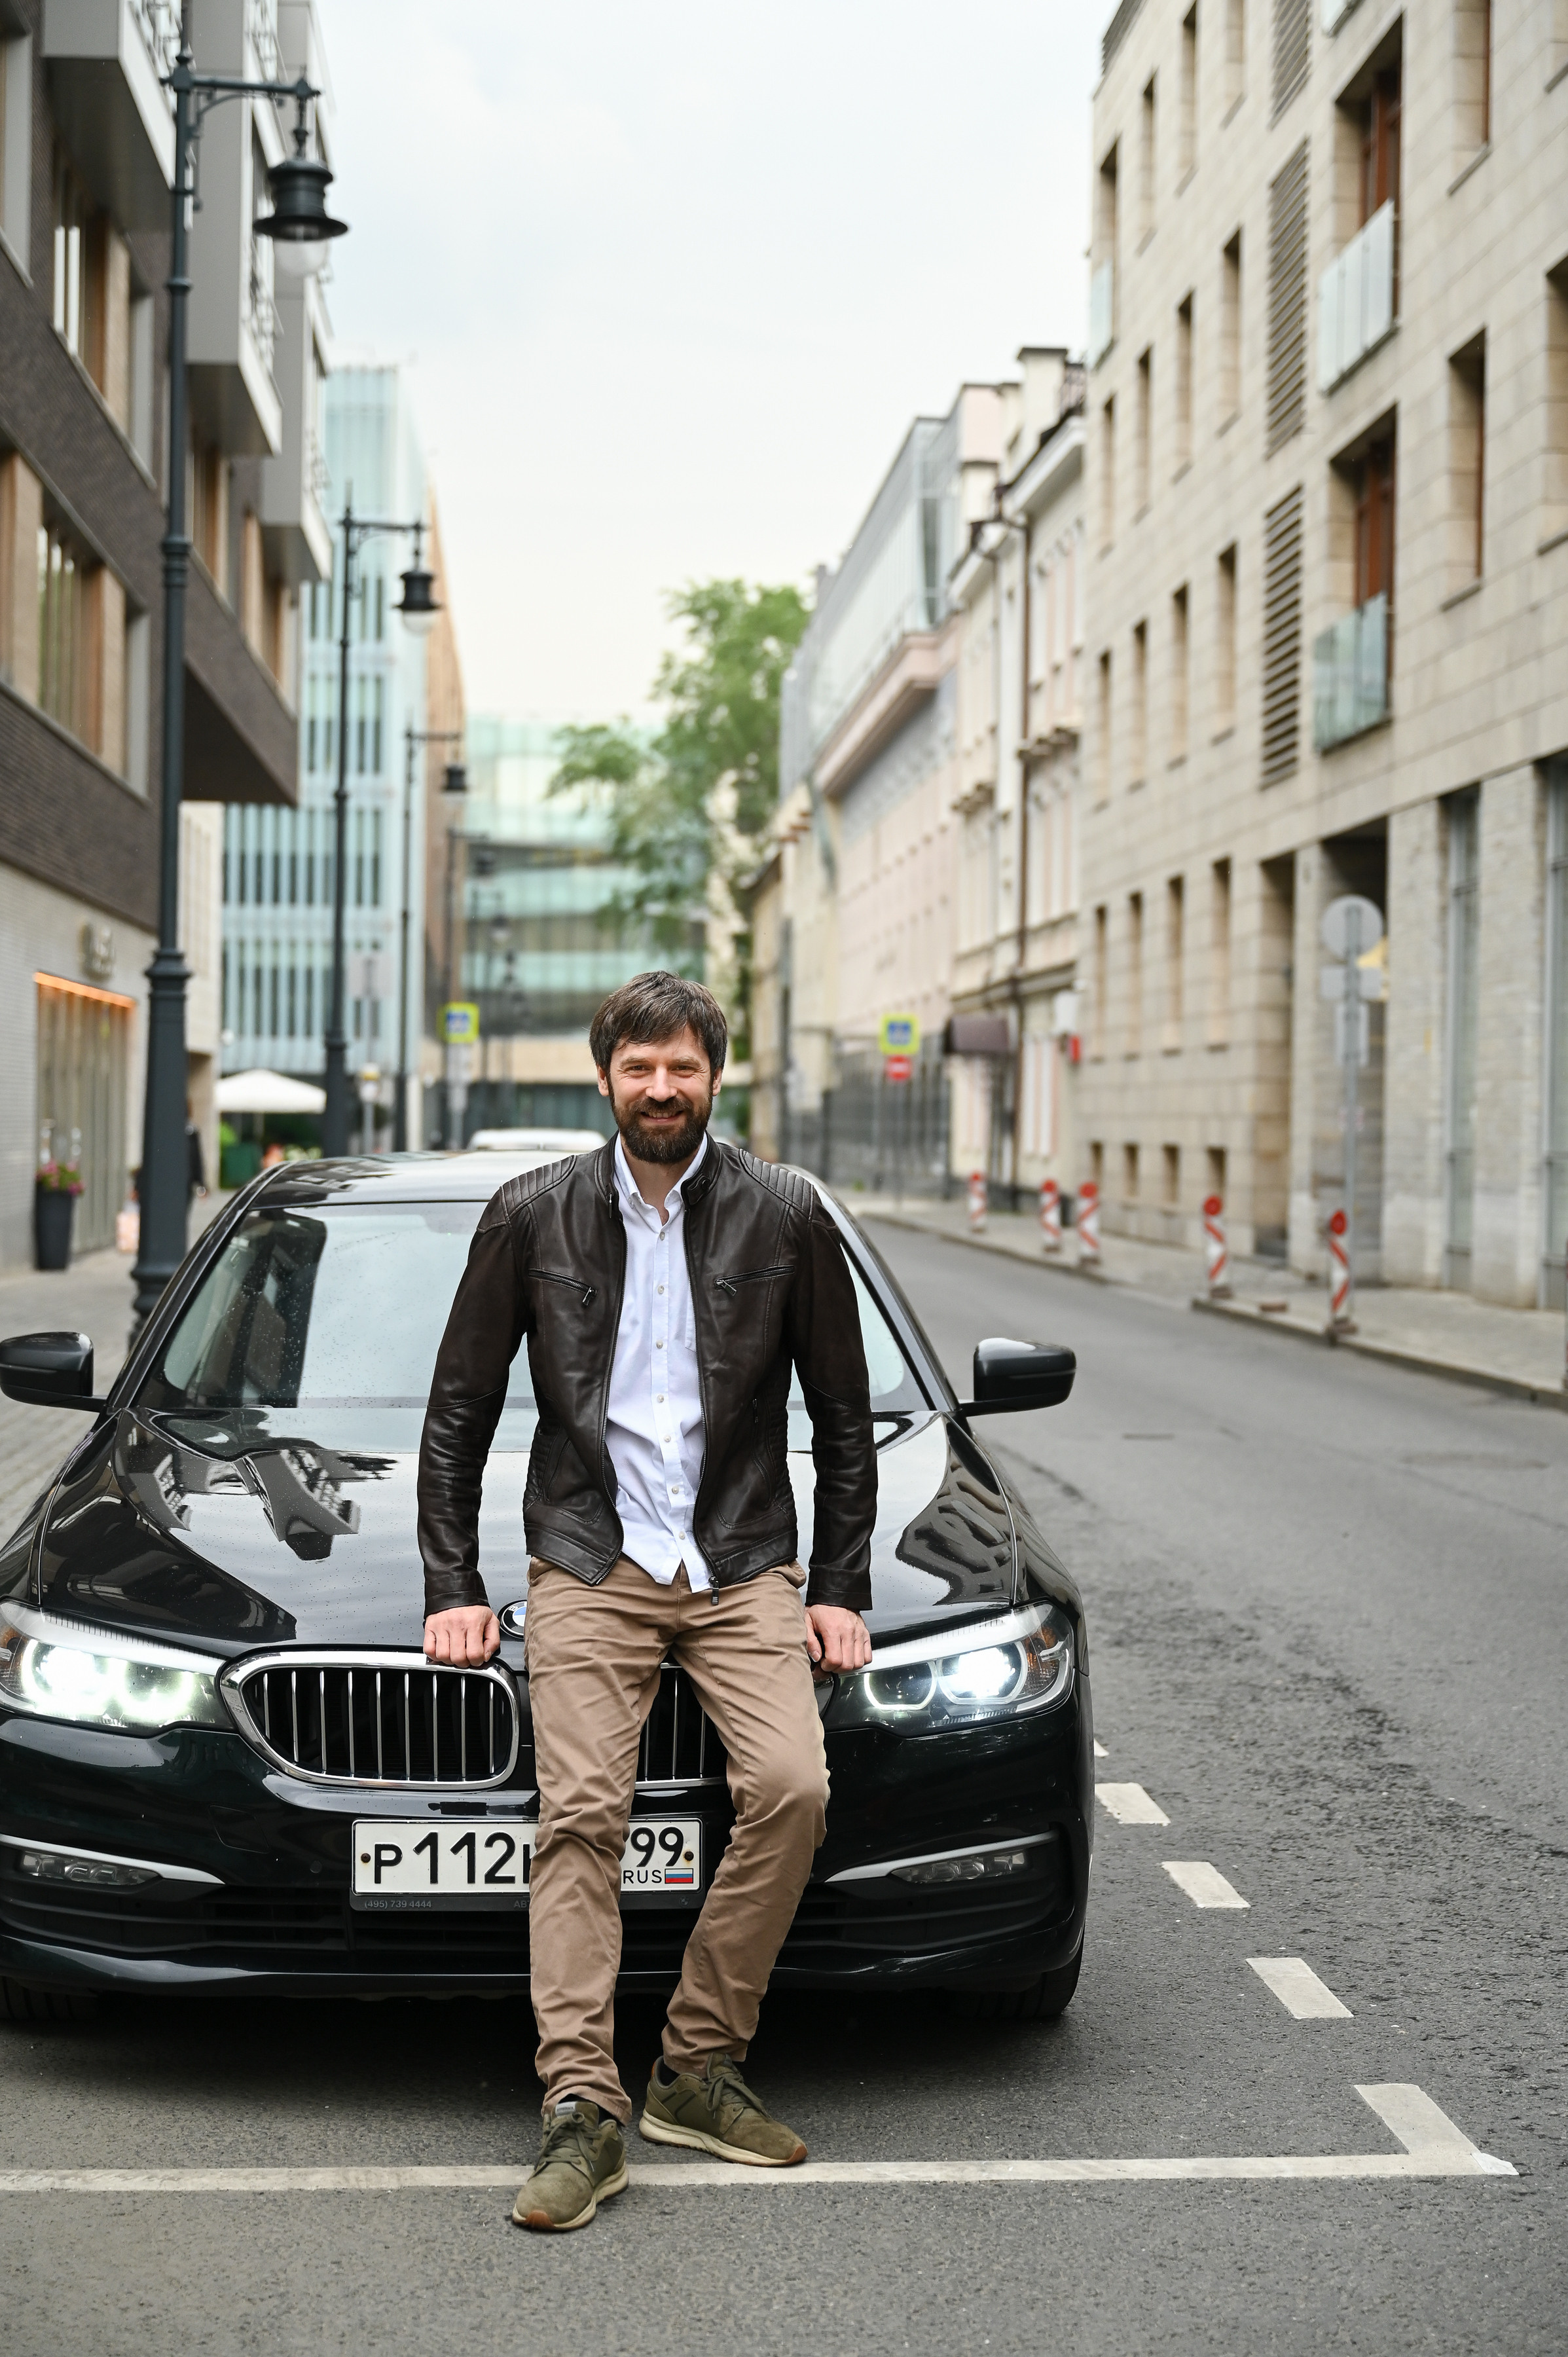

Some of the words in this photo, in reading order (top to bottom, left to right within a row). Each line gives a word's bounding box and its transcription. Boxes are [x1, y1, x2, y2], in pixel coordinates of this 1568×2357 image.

[630, 1826, 684, 1868] 99
[623, 1869, 663, 1884] RUS
[364, 1899, 388, 1909] (495)
[409, 1900, 432, 1909] 4444
